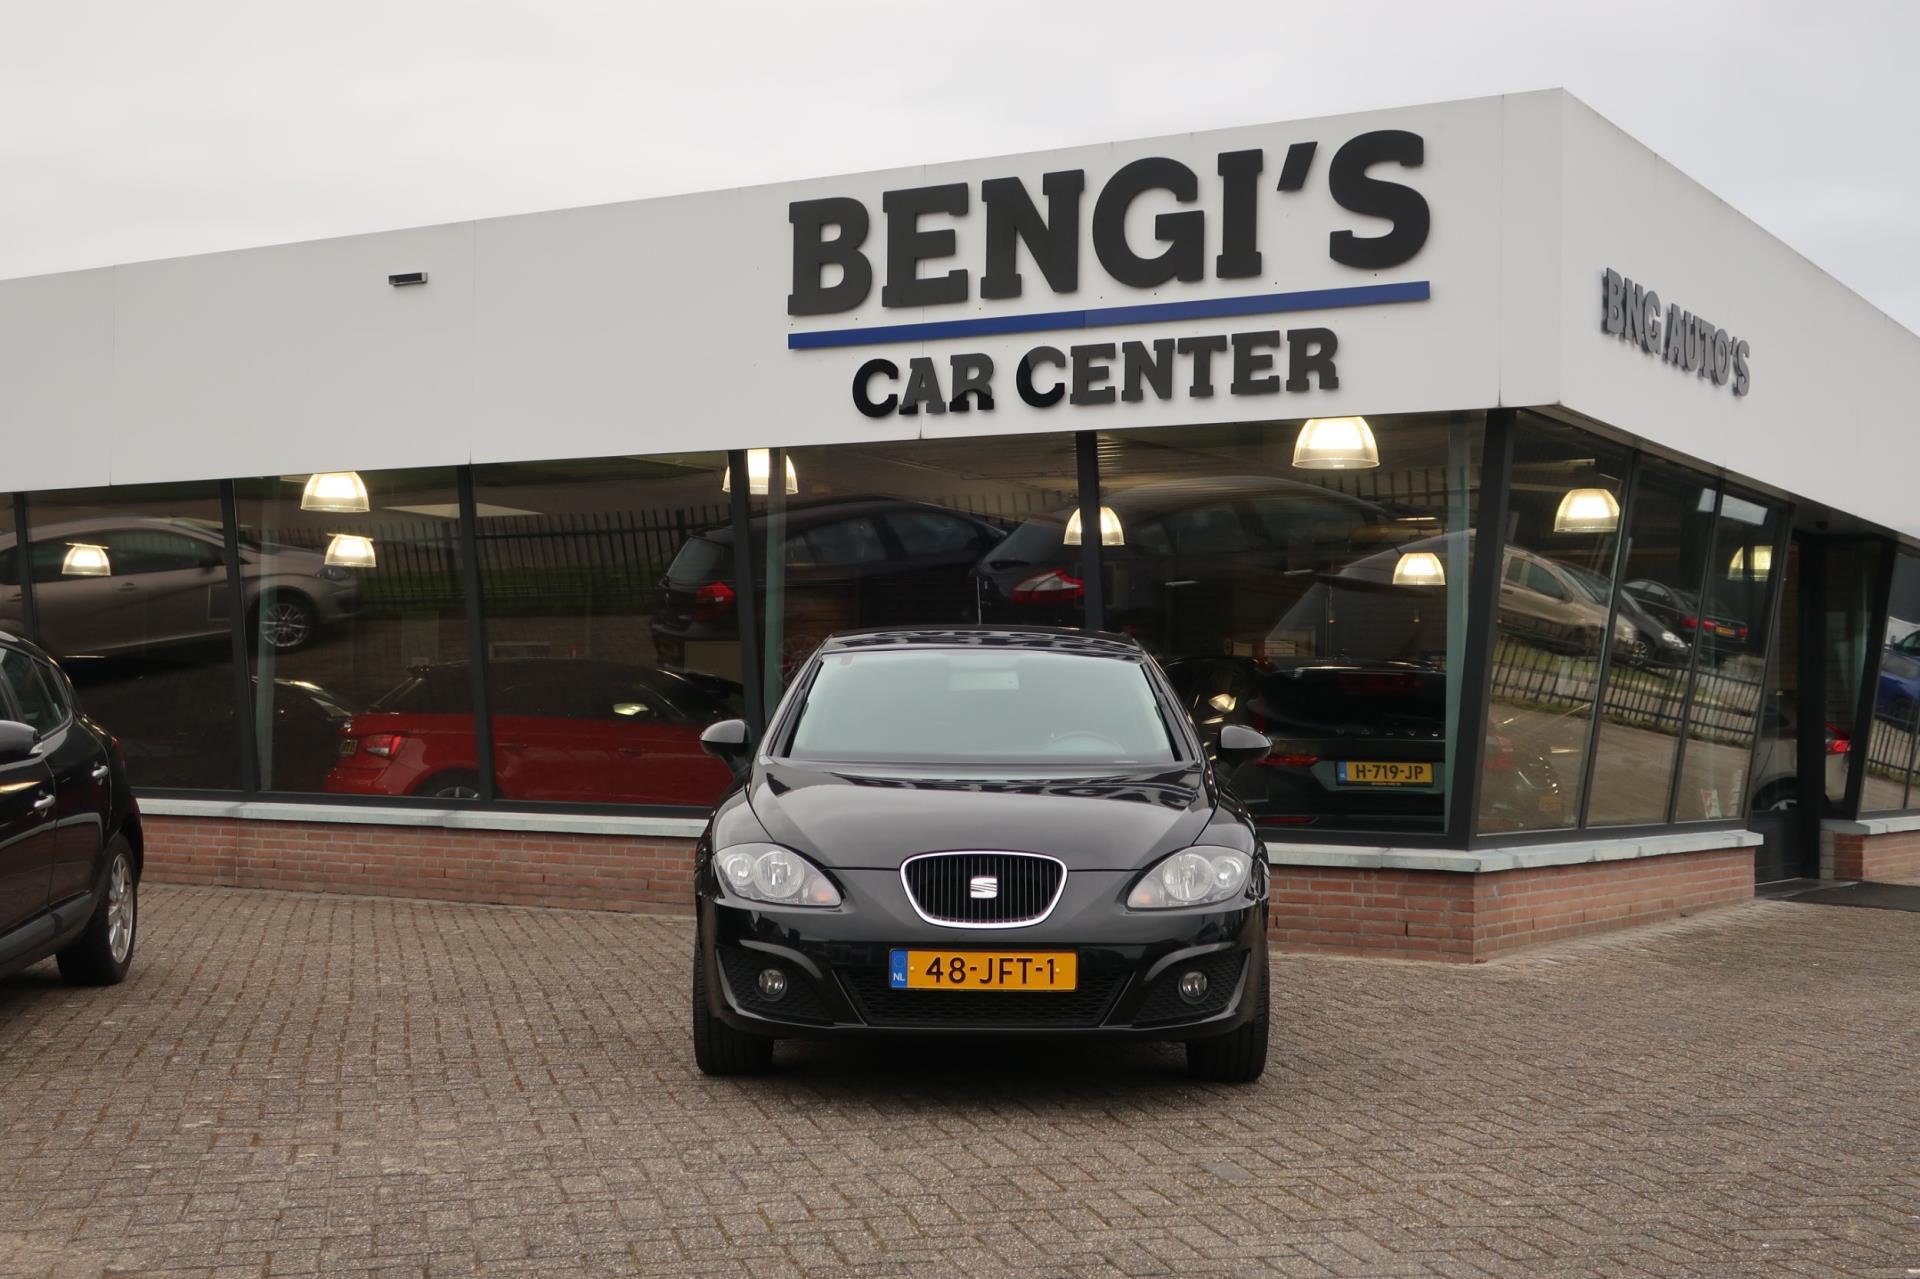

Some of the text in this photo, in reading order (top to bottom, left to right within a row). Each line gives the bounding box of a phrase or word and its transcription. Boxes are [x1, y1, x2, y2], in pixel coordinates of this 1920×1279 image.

[788, 130, 1430, 316] BENGI'S
[852, 327, 1339, 418] CAR CENTER
[1602, 267, 1750, 396] BNG AUTO'S
[1355, 764, 1424, 780] H-719-JP
[893, 956, 1056, 985] NL 48-JFT-1
